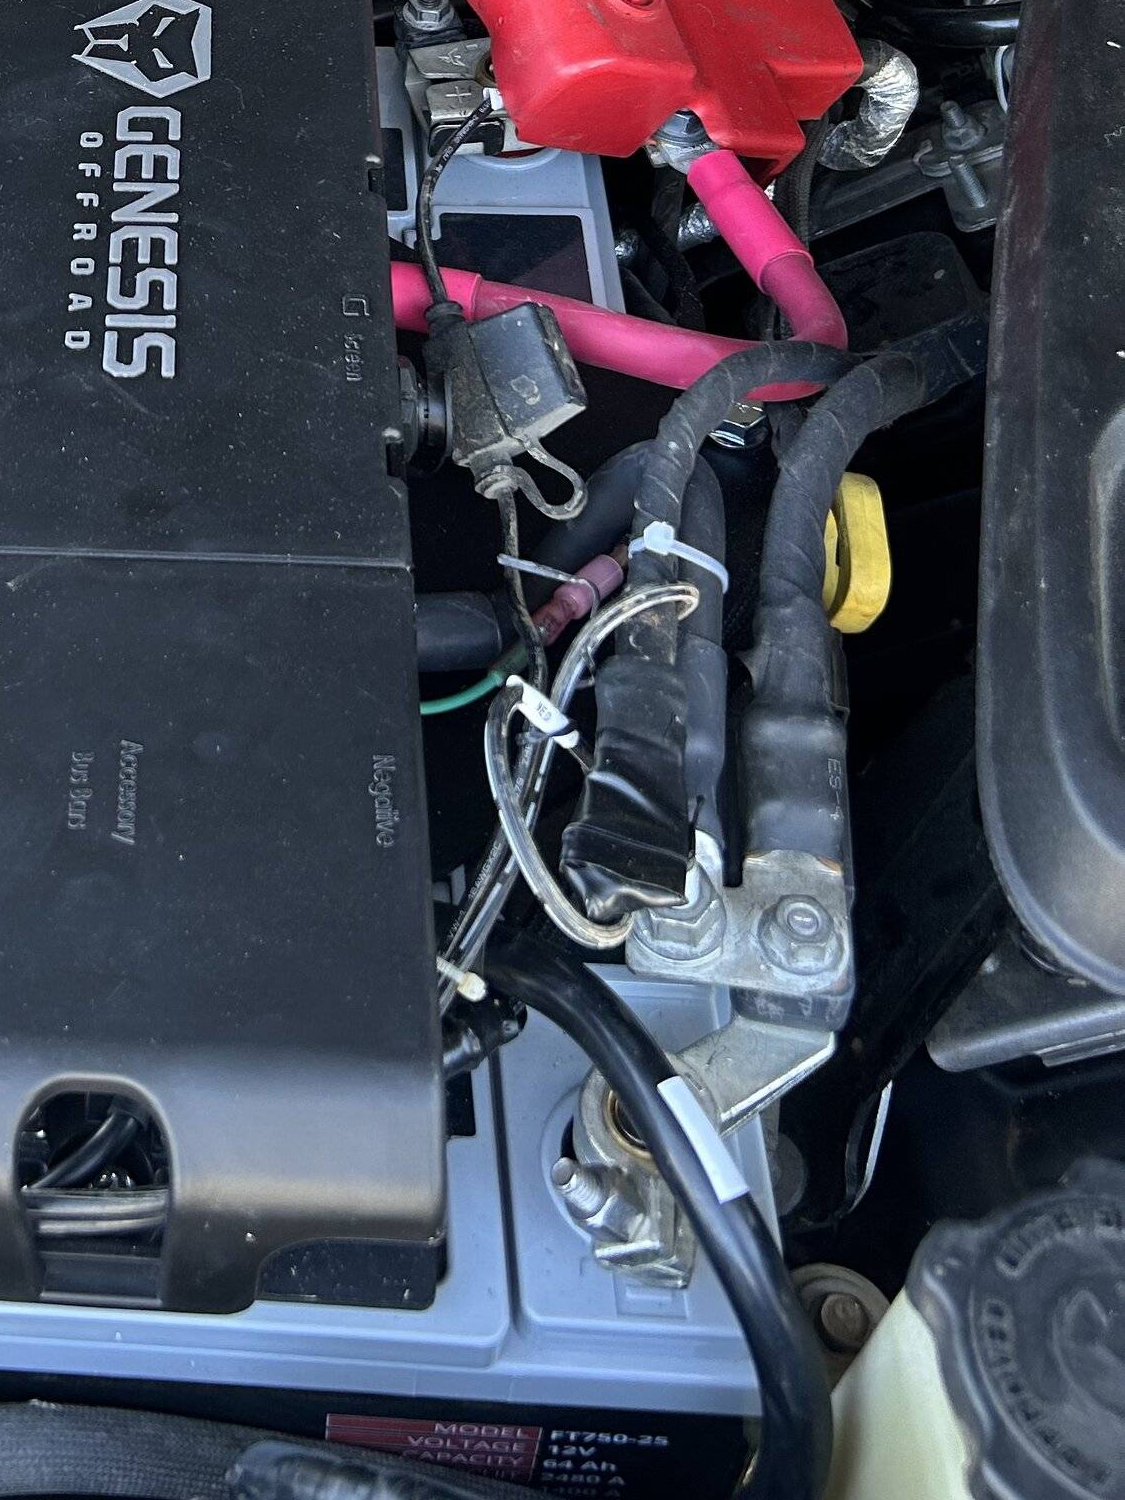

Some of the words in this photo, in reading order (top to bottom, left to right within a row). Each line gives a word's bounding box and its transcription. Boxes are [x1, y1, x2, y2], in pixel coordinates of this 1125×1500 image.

[64, 132, 103, 350] OFFROAD
[102, 106, 180, 379] GENESIS
[69, 751, 94, 783] Bus
[67, 787, 93, 829] Bars
[110, 739, 144, 845] Accessory
[369, 753, 397, 847] Negative
[407, 1435, 525, 1453] VOLTAGE
[548, 1444, 597, 1457] 12V
[434, 1422, 529, 1439] MODEL
[543, 1458, 572, 1470] 64
[580, 1460, 617, 1472] Ah
